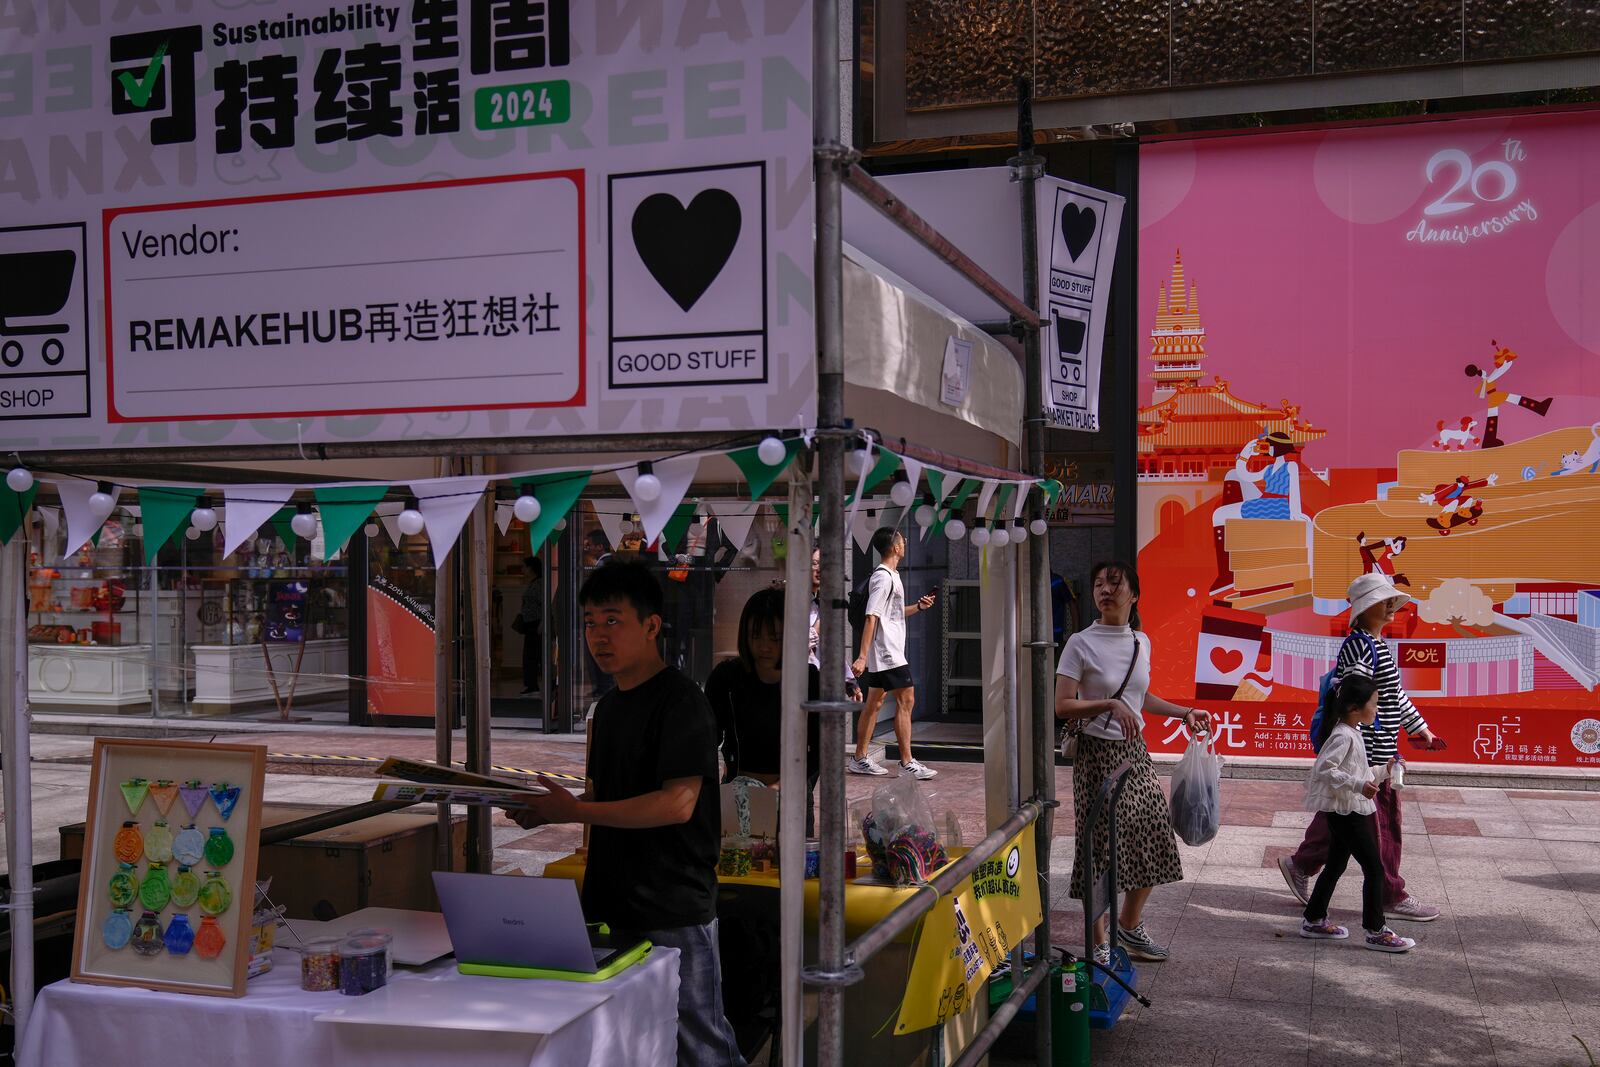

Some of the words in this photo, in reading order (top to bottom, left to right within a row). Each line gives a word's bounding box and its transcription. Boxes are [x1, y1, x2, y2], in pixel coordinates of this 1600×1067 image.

[212, 4, 400, 46] Sustainability
[489, 88, 553, 123] 2024
[1405, 198, 1539, 244] Anniversary
[122, 223, 239, 259] Vendor:
[1051, 277, 1070, 290] GOOD
[1071, 282, 1092, 295] STUFF
[129, 292, 561, 352] REMAKEHUB再造狂想社
[617, 352, 682, 373] GOOD
[687, 348, 757, 371] STUFF
[0, 388, 54, 409] SHOP
[1061, 389, 1078, 402] SHOP
[1075, 411, 1096, 430] PLACE
[404, 595, 436, 623] ANNIVERSA
[1504, 744, 1558, 755] 扫码关注
